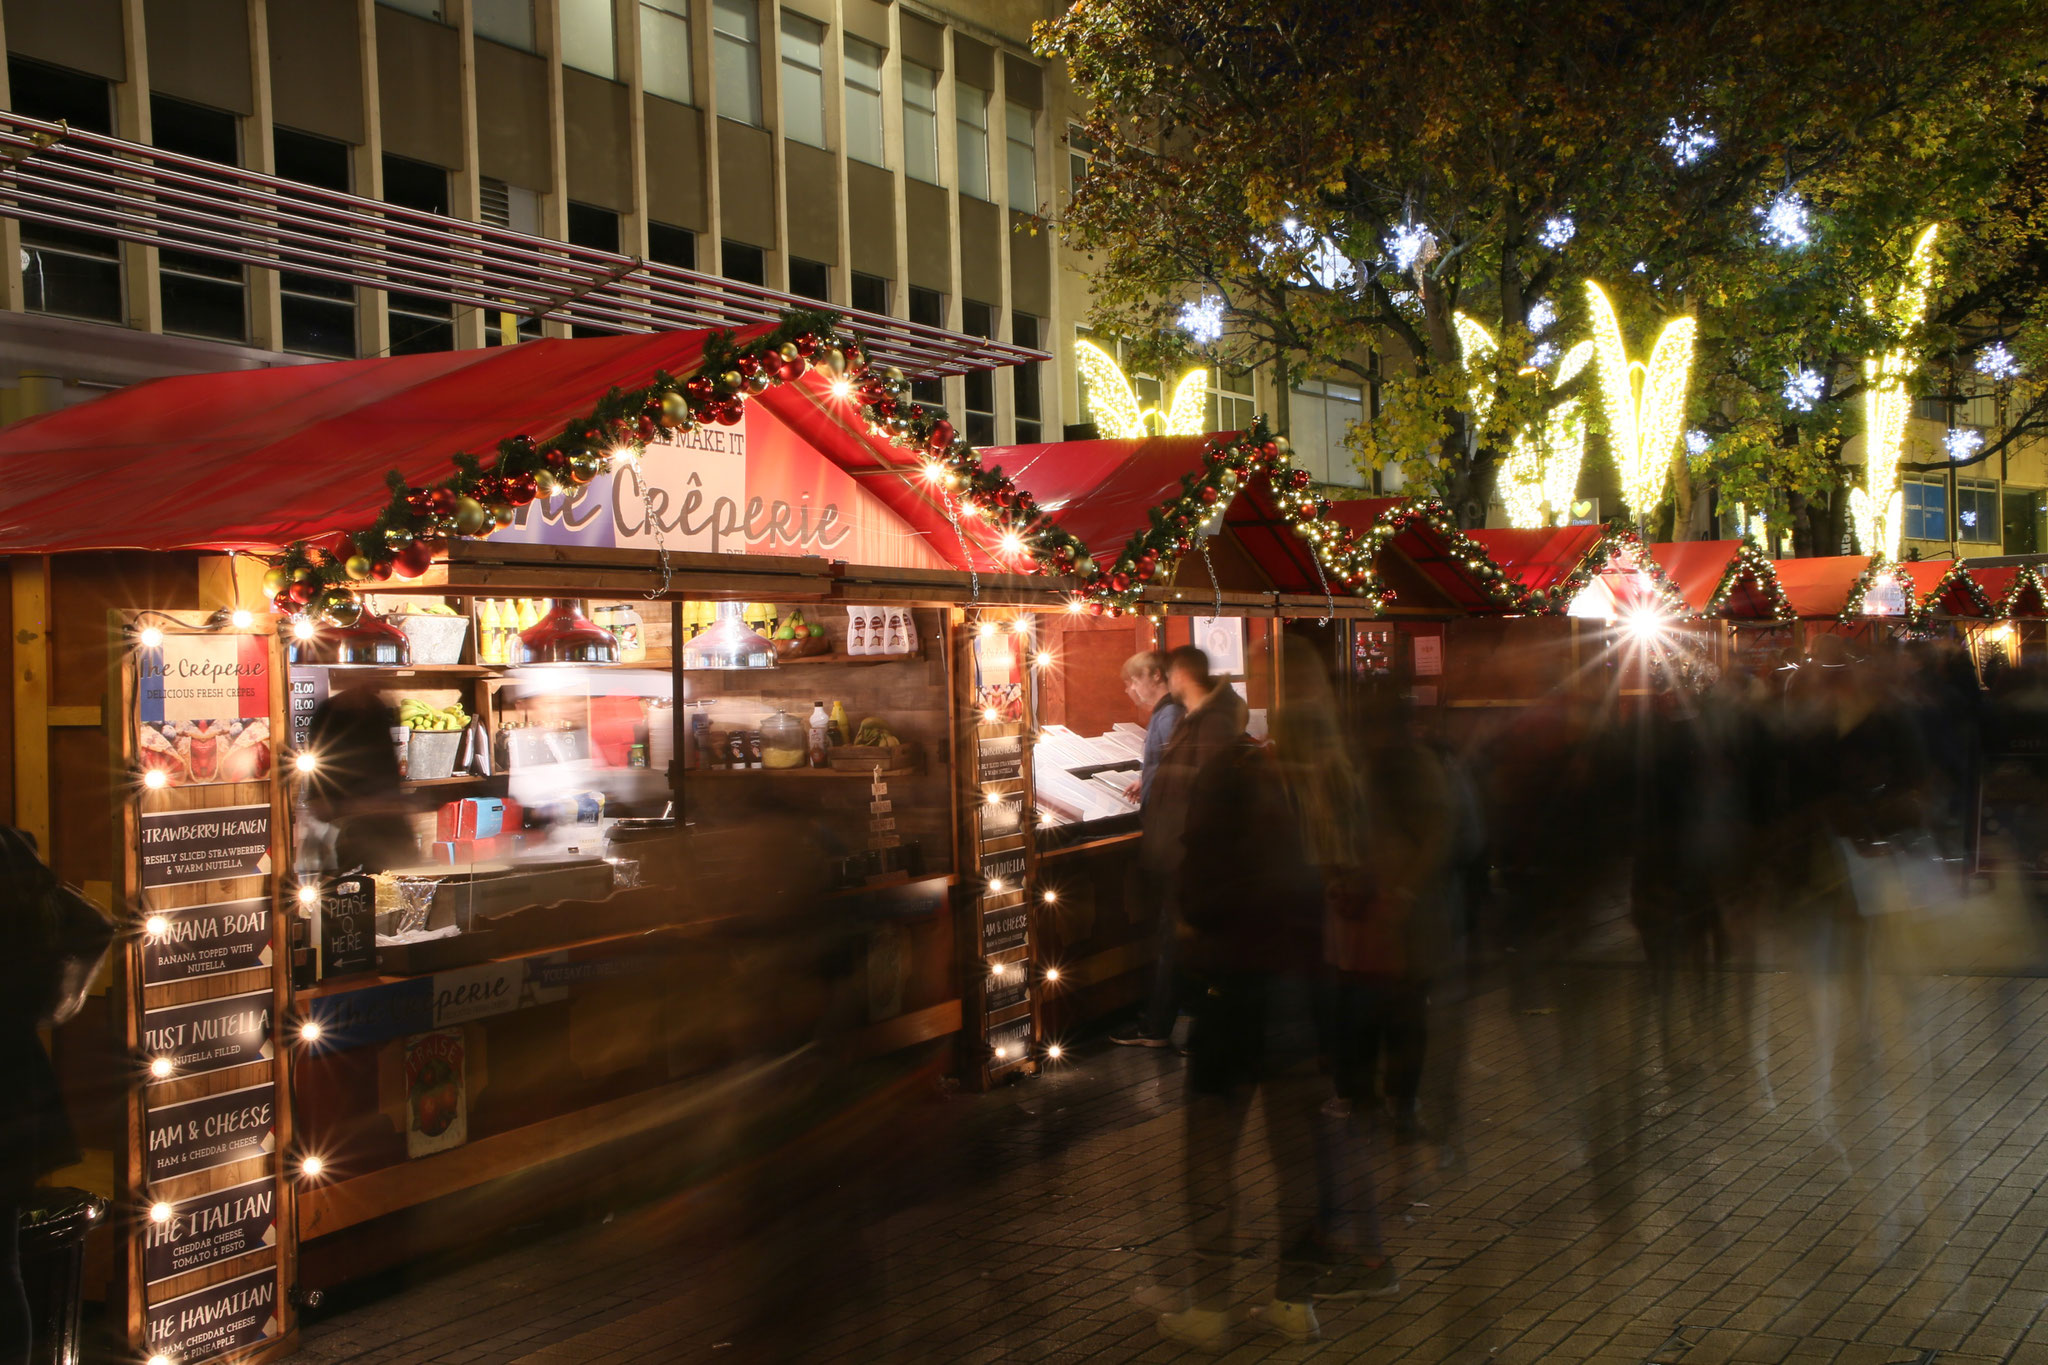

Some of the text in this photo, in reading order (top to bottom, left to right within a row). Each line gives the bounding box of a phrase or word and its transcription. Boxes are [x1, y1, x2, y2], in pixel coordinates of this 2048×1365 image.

[676, 428, 725, 453] MAKE
[729, 432, 744, 456] IT
[610, 462, 851, 554] Crêperie
[178, 658, 265, 684] Crêperie
[147, 686, 255, 699] DELICIOUS FRESH CRÊPES
[142, 818, 267, 844] TRAWBERRY HEAVEN
[143, 844, 266, 866] RESHLY SLICED STRAWBERRIES
[166, 859, 243, 875] & WARM NUTELLA
[328, 894, 368, 919] PLEASE
[222, 910, 268, 937] BOAT
[342, 916, 355, 934] Q
[1002, 913, 1027, 932] CHEESE
[158, 943, 253, 966] BANANA TOPPED WITH
[331, 932, 363, 953] HERE
[187, 960, 226, 974] NUTELLA
[145, 1008, 270, 1052] JUST NUTELLA
[173, 1044, 241, 1066] NUTELLA FILLED
[408, 1038, 458, 1073] FRAISE
[188, 1120, 200, 1141] &
[204, 1102, 272, 1137] CHEESE
[157, 1135, 258, 1169] HAM & CHEDDAR CHEESE
[189, 1190, 272, 1237] ITALIAN
[172, 1228, 245, 1257] CHEDDAR CHEESE,
[172, 1239, 246, 1270] TOMATO & PESTO
[149, 1281, 273, 1343] HE HAWAIIAN
[186, 1326, 225, 1348] CHEDDAR
[226, 1315, 256, 1333] CHEESE
[183, 1334, 236, 1361] & PINEAPPLE
